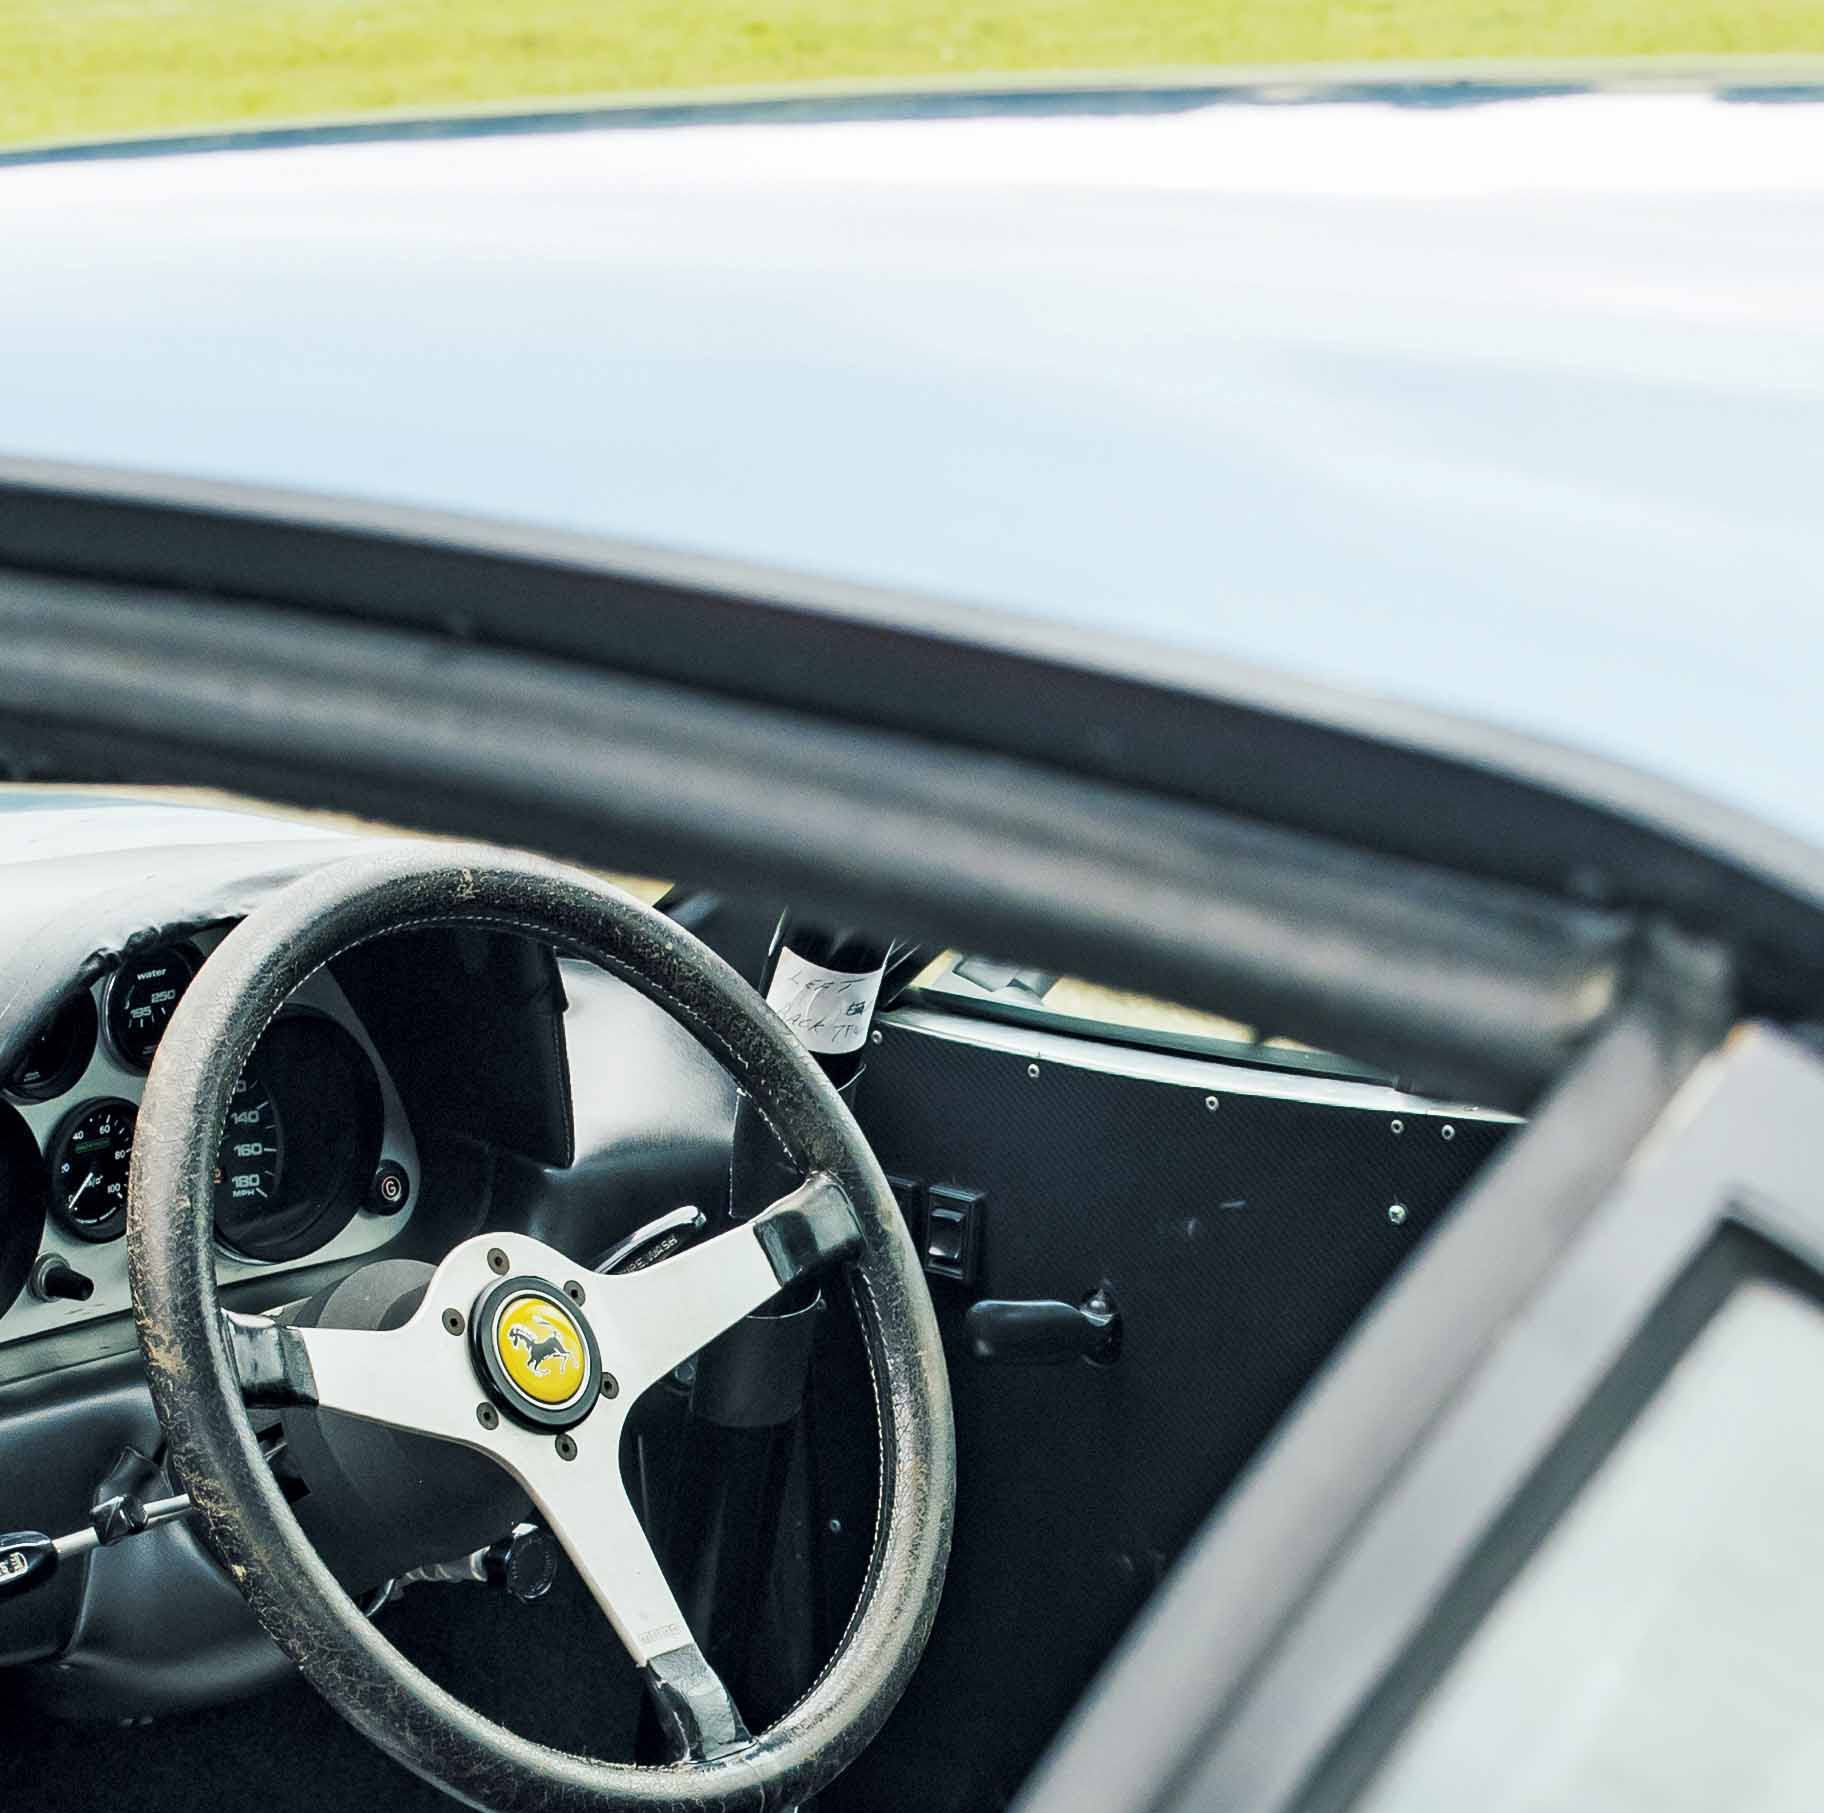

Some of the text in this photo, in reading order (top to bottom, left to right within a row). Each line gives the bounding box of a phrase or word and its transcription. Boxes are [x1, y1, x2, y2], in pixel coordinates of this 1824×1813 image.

[136, 968, 167, 981] water
[151, 988, 176, 1004] 250
[231, 1109, 261, 1124] 140
[99, 1124, 111, 1135] 60
[114, 1149, 126, 1161] 80
[233, 1142, 263, 1158] 160
[107, 1181, 121, 1194] 100
[232, 1173, 261, 1189] 180
[232, 1188, 256, 1198] MPH
